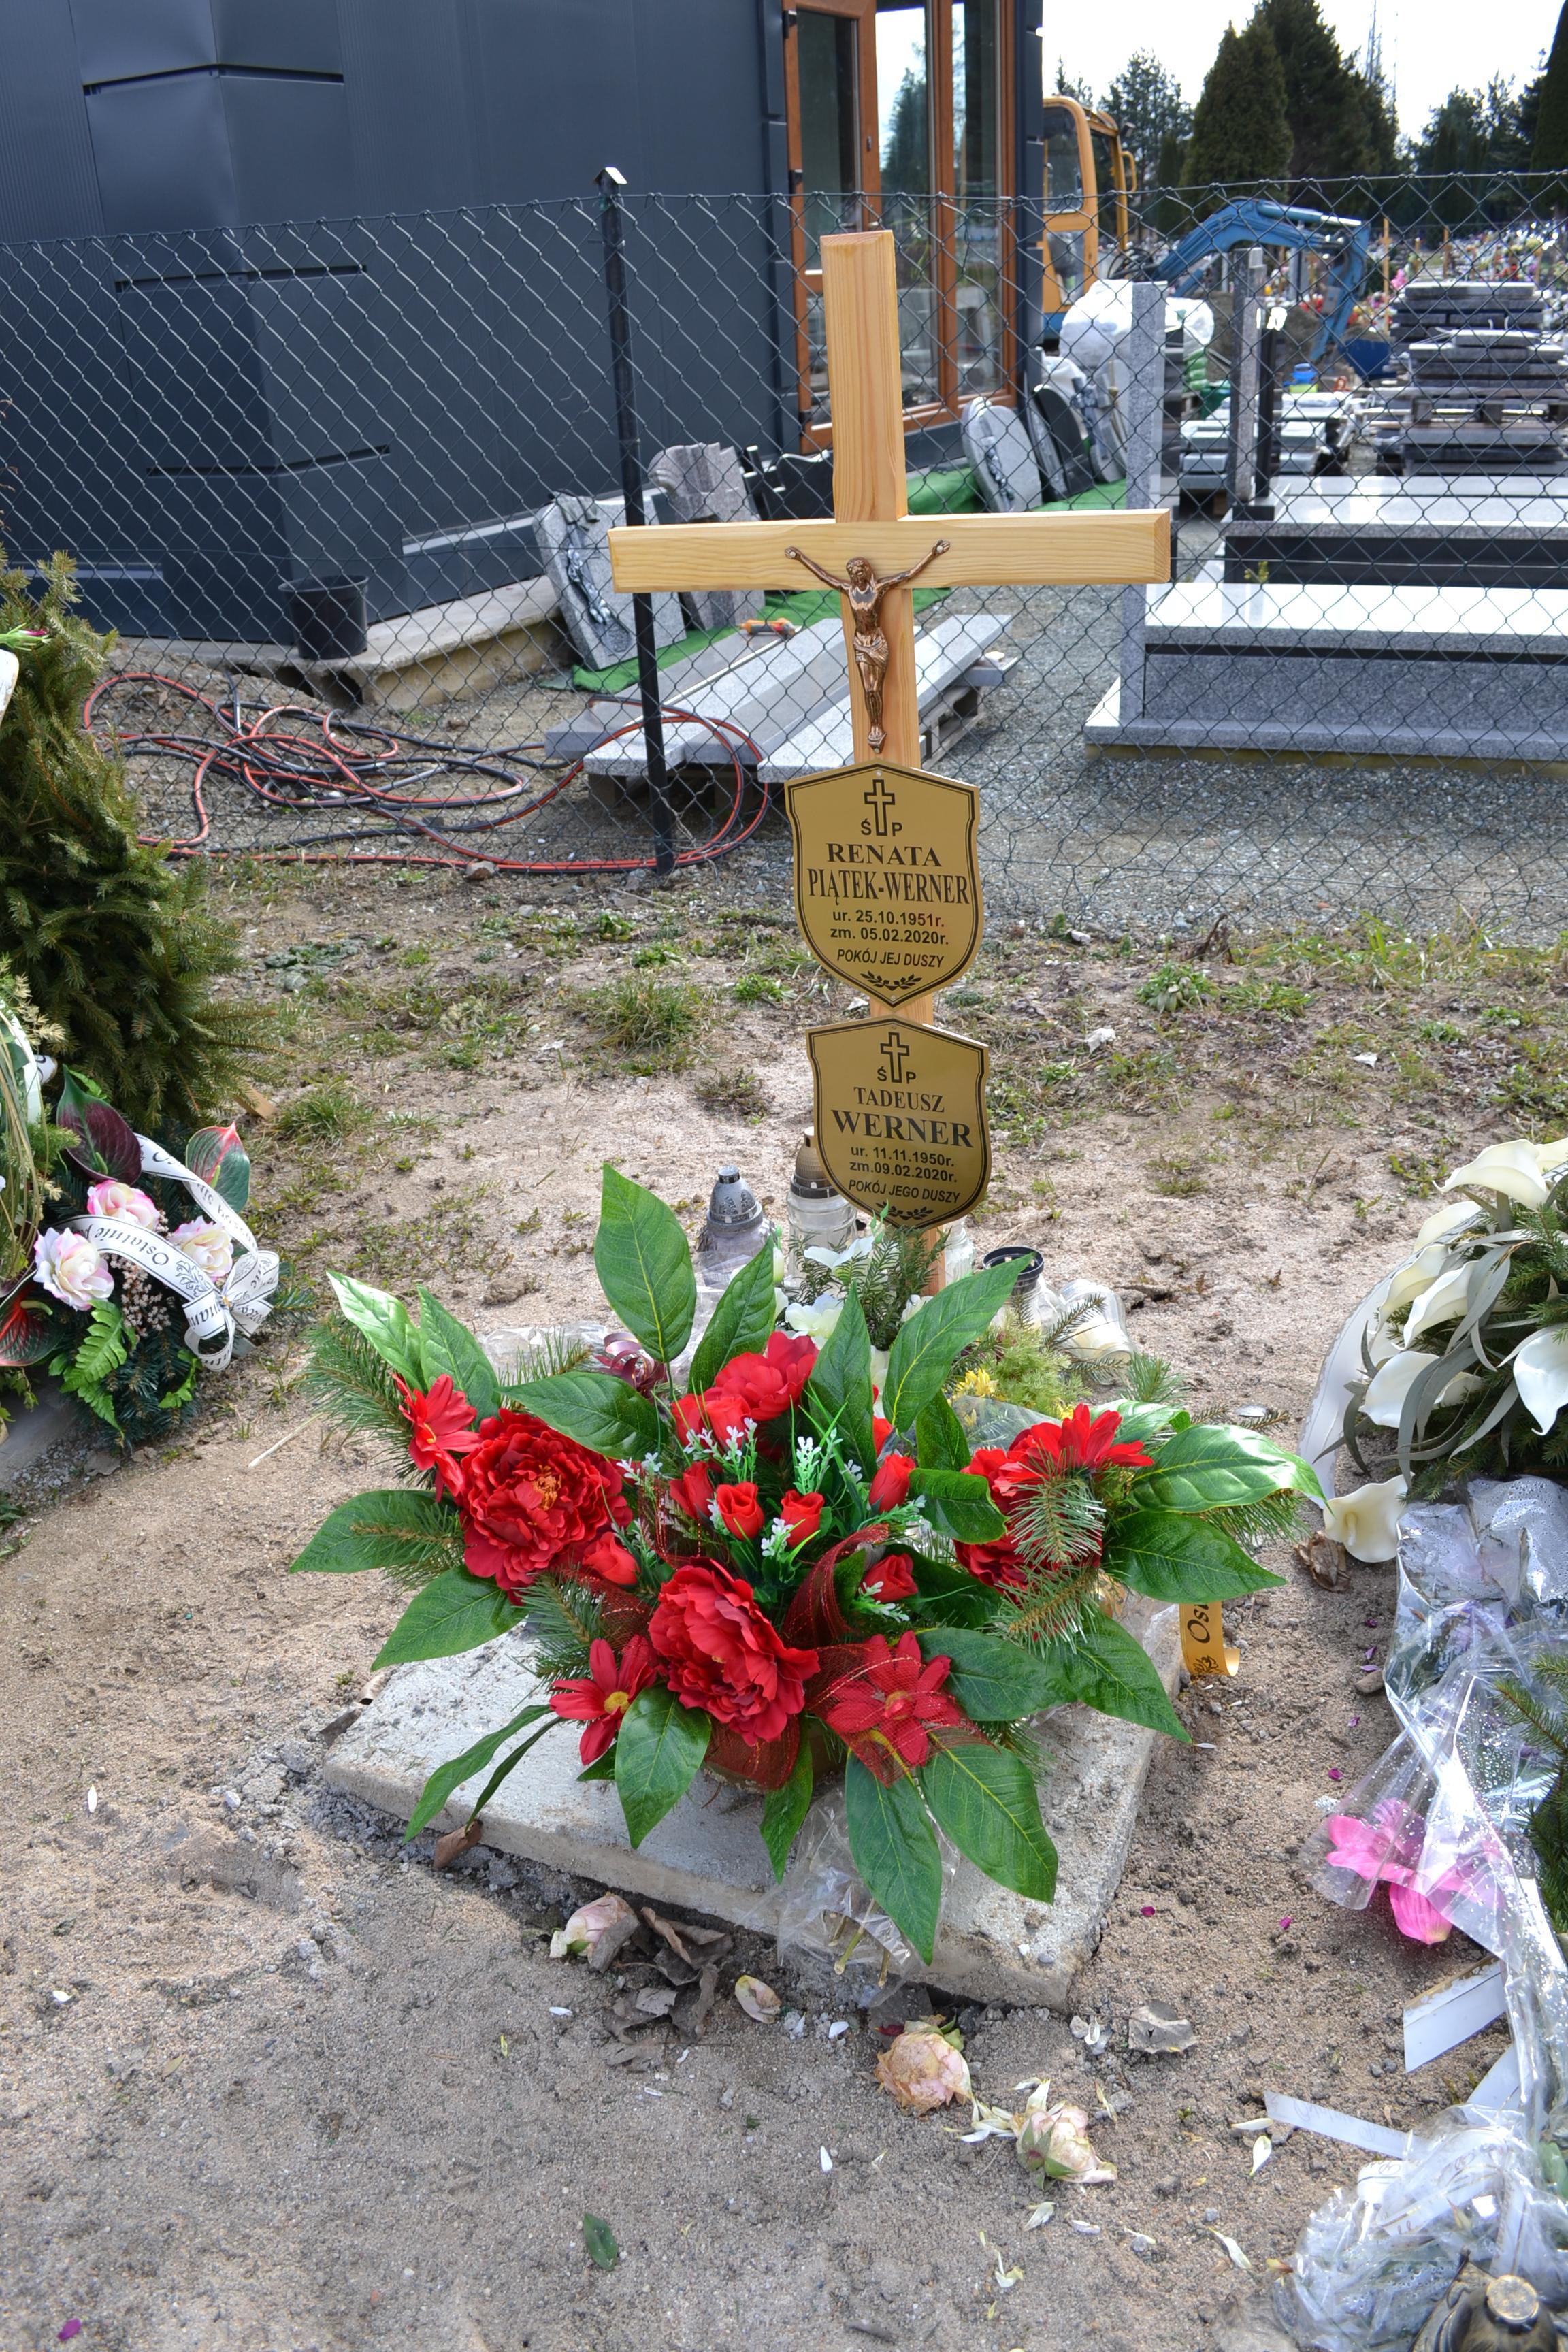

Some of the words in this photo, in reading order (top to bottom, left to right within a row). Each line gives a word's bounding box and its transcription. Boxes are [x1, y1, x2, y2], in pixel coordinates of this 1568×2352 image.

[861, 818, 872, 836] Ś
[892, 822, 902, 836] P
[826, 843, 943, 867] RENATA
[807, 868, 970, 906] PIĄTEK-WERNER
[833, 911, 851, 922] ur.
[855, 910, 945, 927] 25.10.1951r.
[830, 928, 855, 939] zm.
[860, 928, 949, 945] 05.02.2020r.
[837, 948, 877, 964] POKÓJ
[880, 951, 901, 965] JEJ
[904, 953, 944, 968] DUSZY
[877, 1066, 887, 1081] Ś
[906, 1071, 916, 1084] P
[854, 1086, 945, 1113] TADEUSZ
[831, 1109, 974, 1148] WERNER
[851, 1146, 868, 1157] ur.
[873, 1147, 954, 1166] 11.11.1950r.
[849, 1179, 887, 1194] POKÓJ
[889, 1183, 919, 1198] JEGO
[922, 1188, 960, 1204] DUSZY
[94, 1227, 169, 1267] Ostatnie
